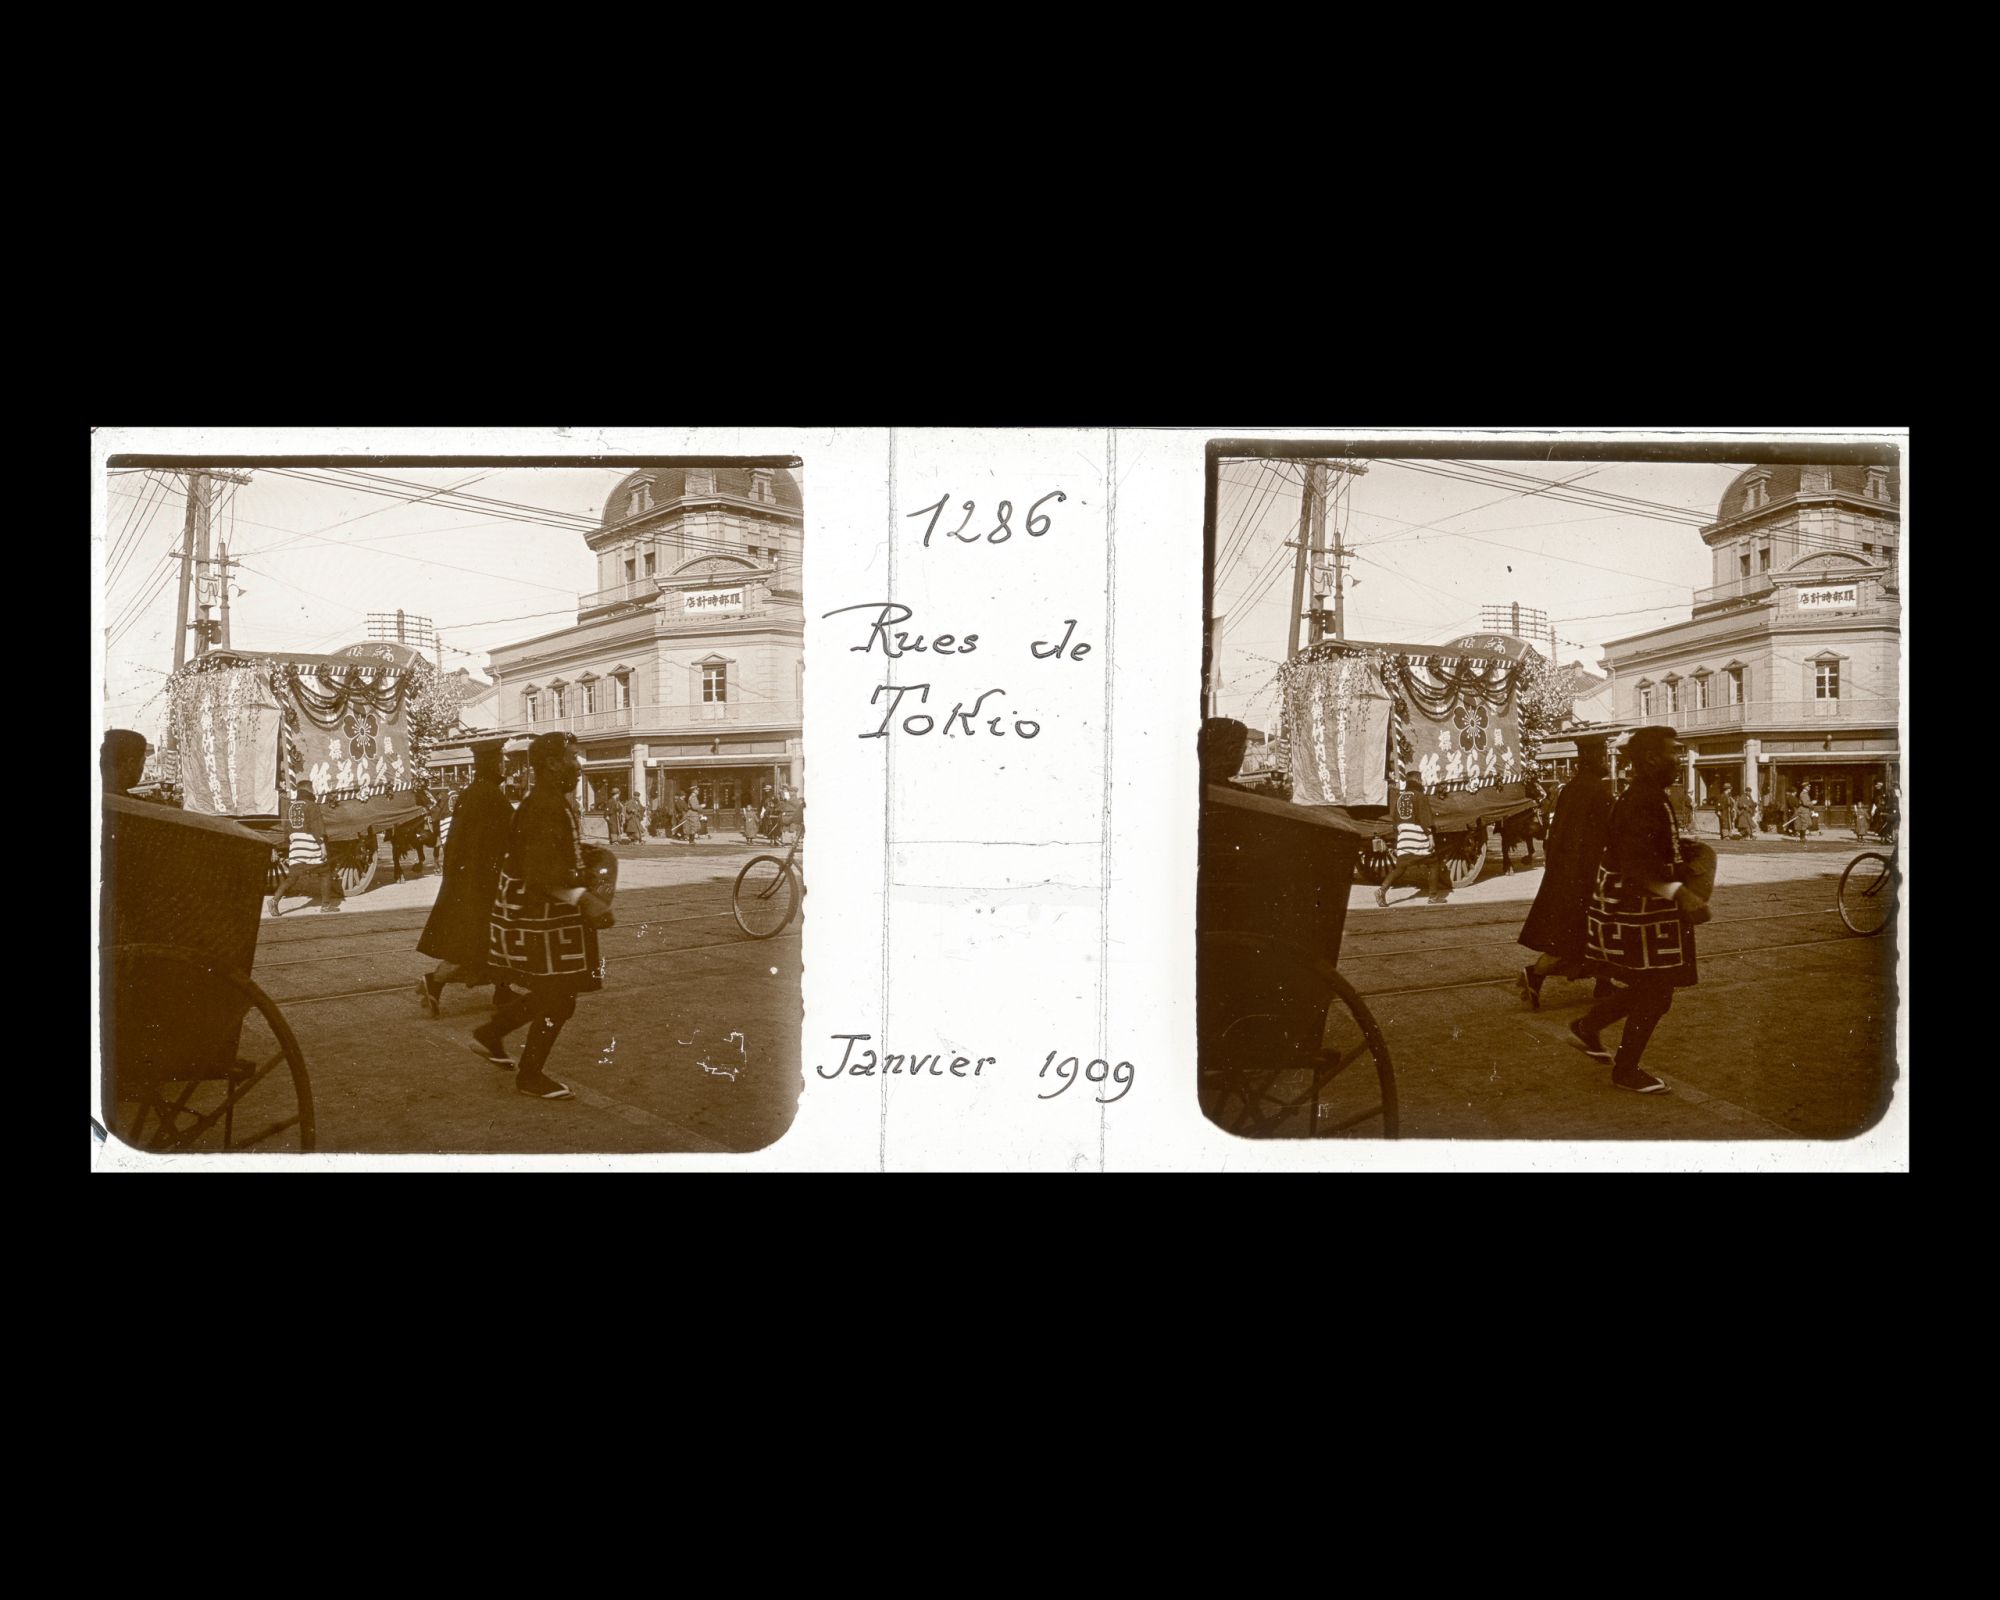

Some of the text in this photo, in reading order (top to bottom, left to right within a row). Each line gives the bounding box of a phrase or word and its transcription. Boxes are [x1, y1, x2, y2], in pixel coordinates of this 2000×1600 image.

[906, 491, 1067, 547] 1286
[822, 602, 1092, 661] Rues de
[816, 1034, 1135, 1103] Janvier 1909
